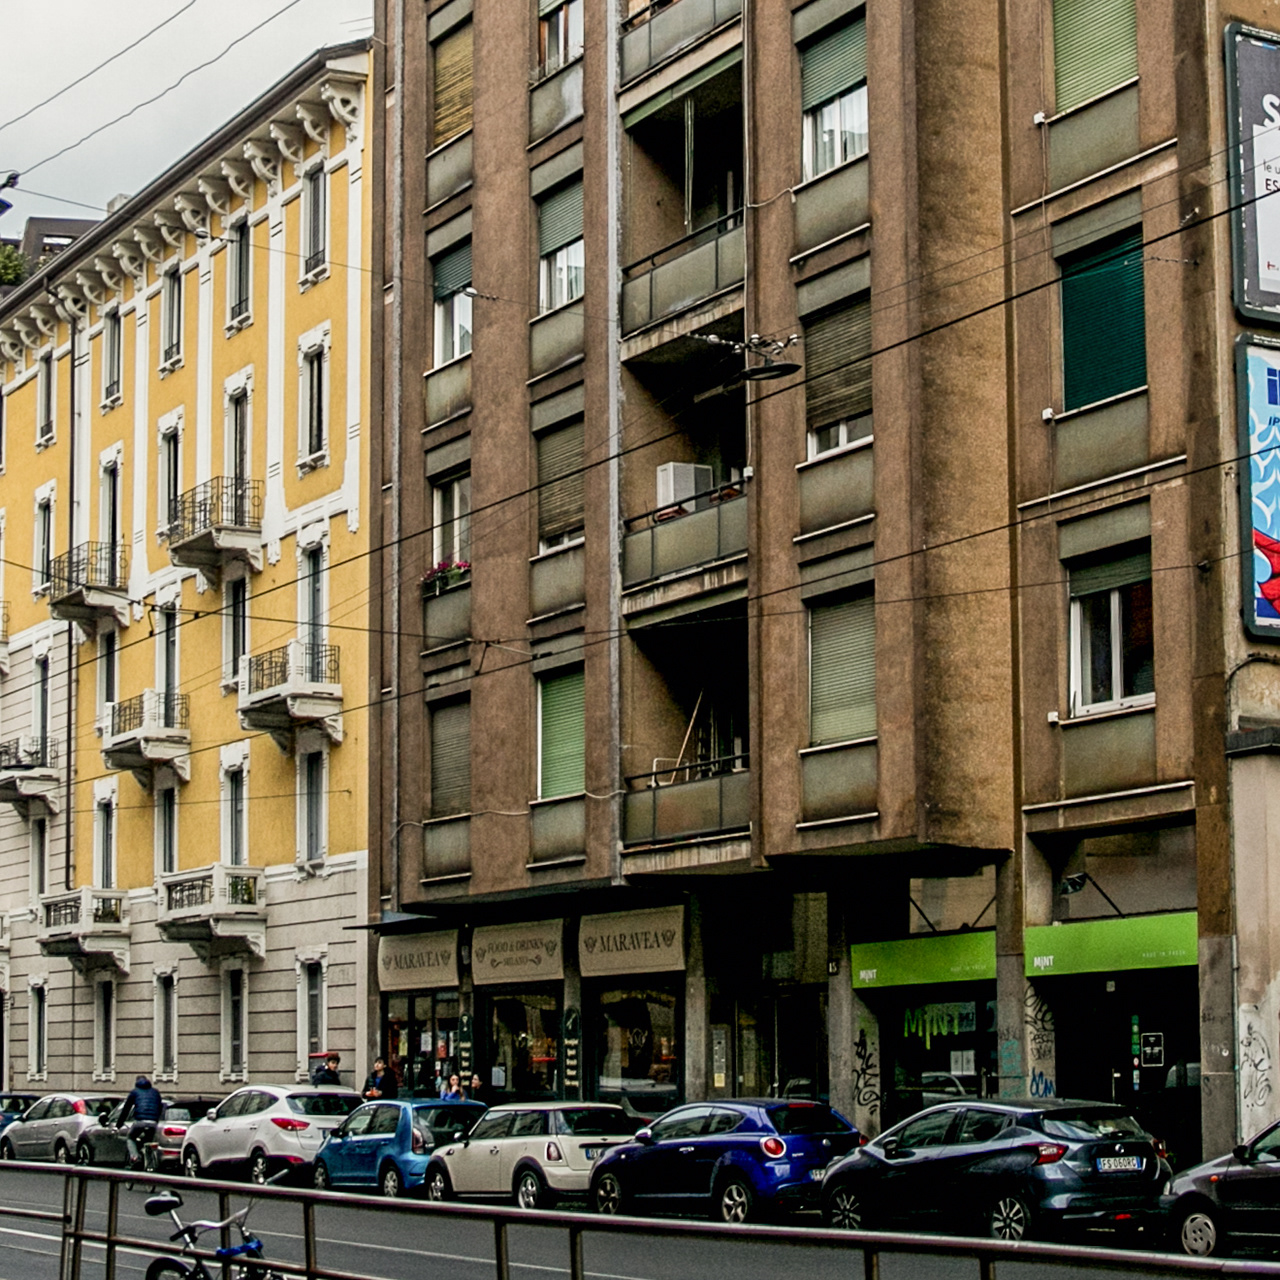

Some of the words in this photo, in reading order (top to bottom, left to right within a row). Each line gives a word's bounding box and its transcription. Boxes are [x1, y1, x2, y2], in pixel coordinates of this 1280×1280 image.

[1263, 159, 1272, 171] le
[487, 941, 508, 954] FOOD
[515, 938, 545, 952] DRINKS
[600, 930, 661, 953] MARAVEA
[393, 951, 440, 969] MARAVEA
[1102, 1160, 1112, 1169] FS
